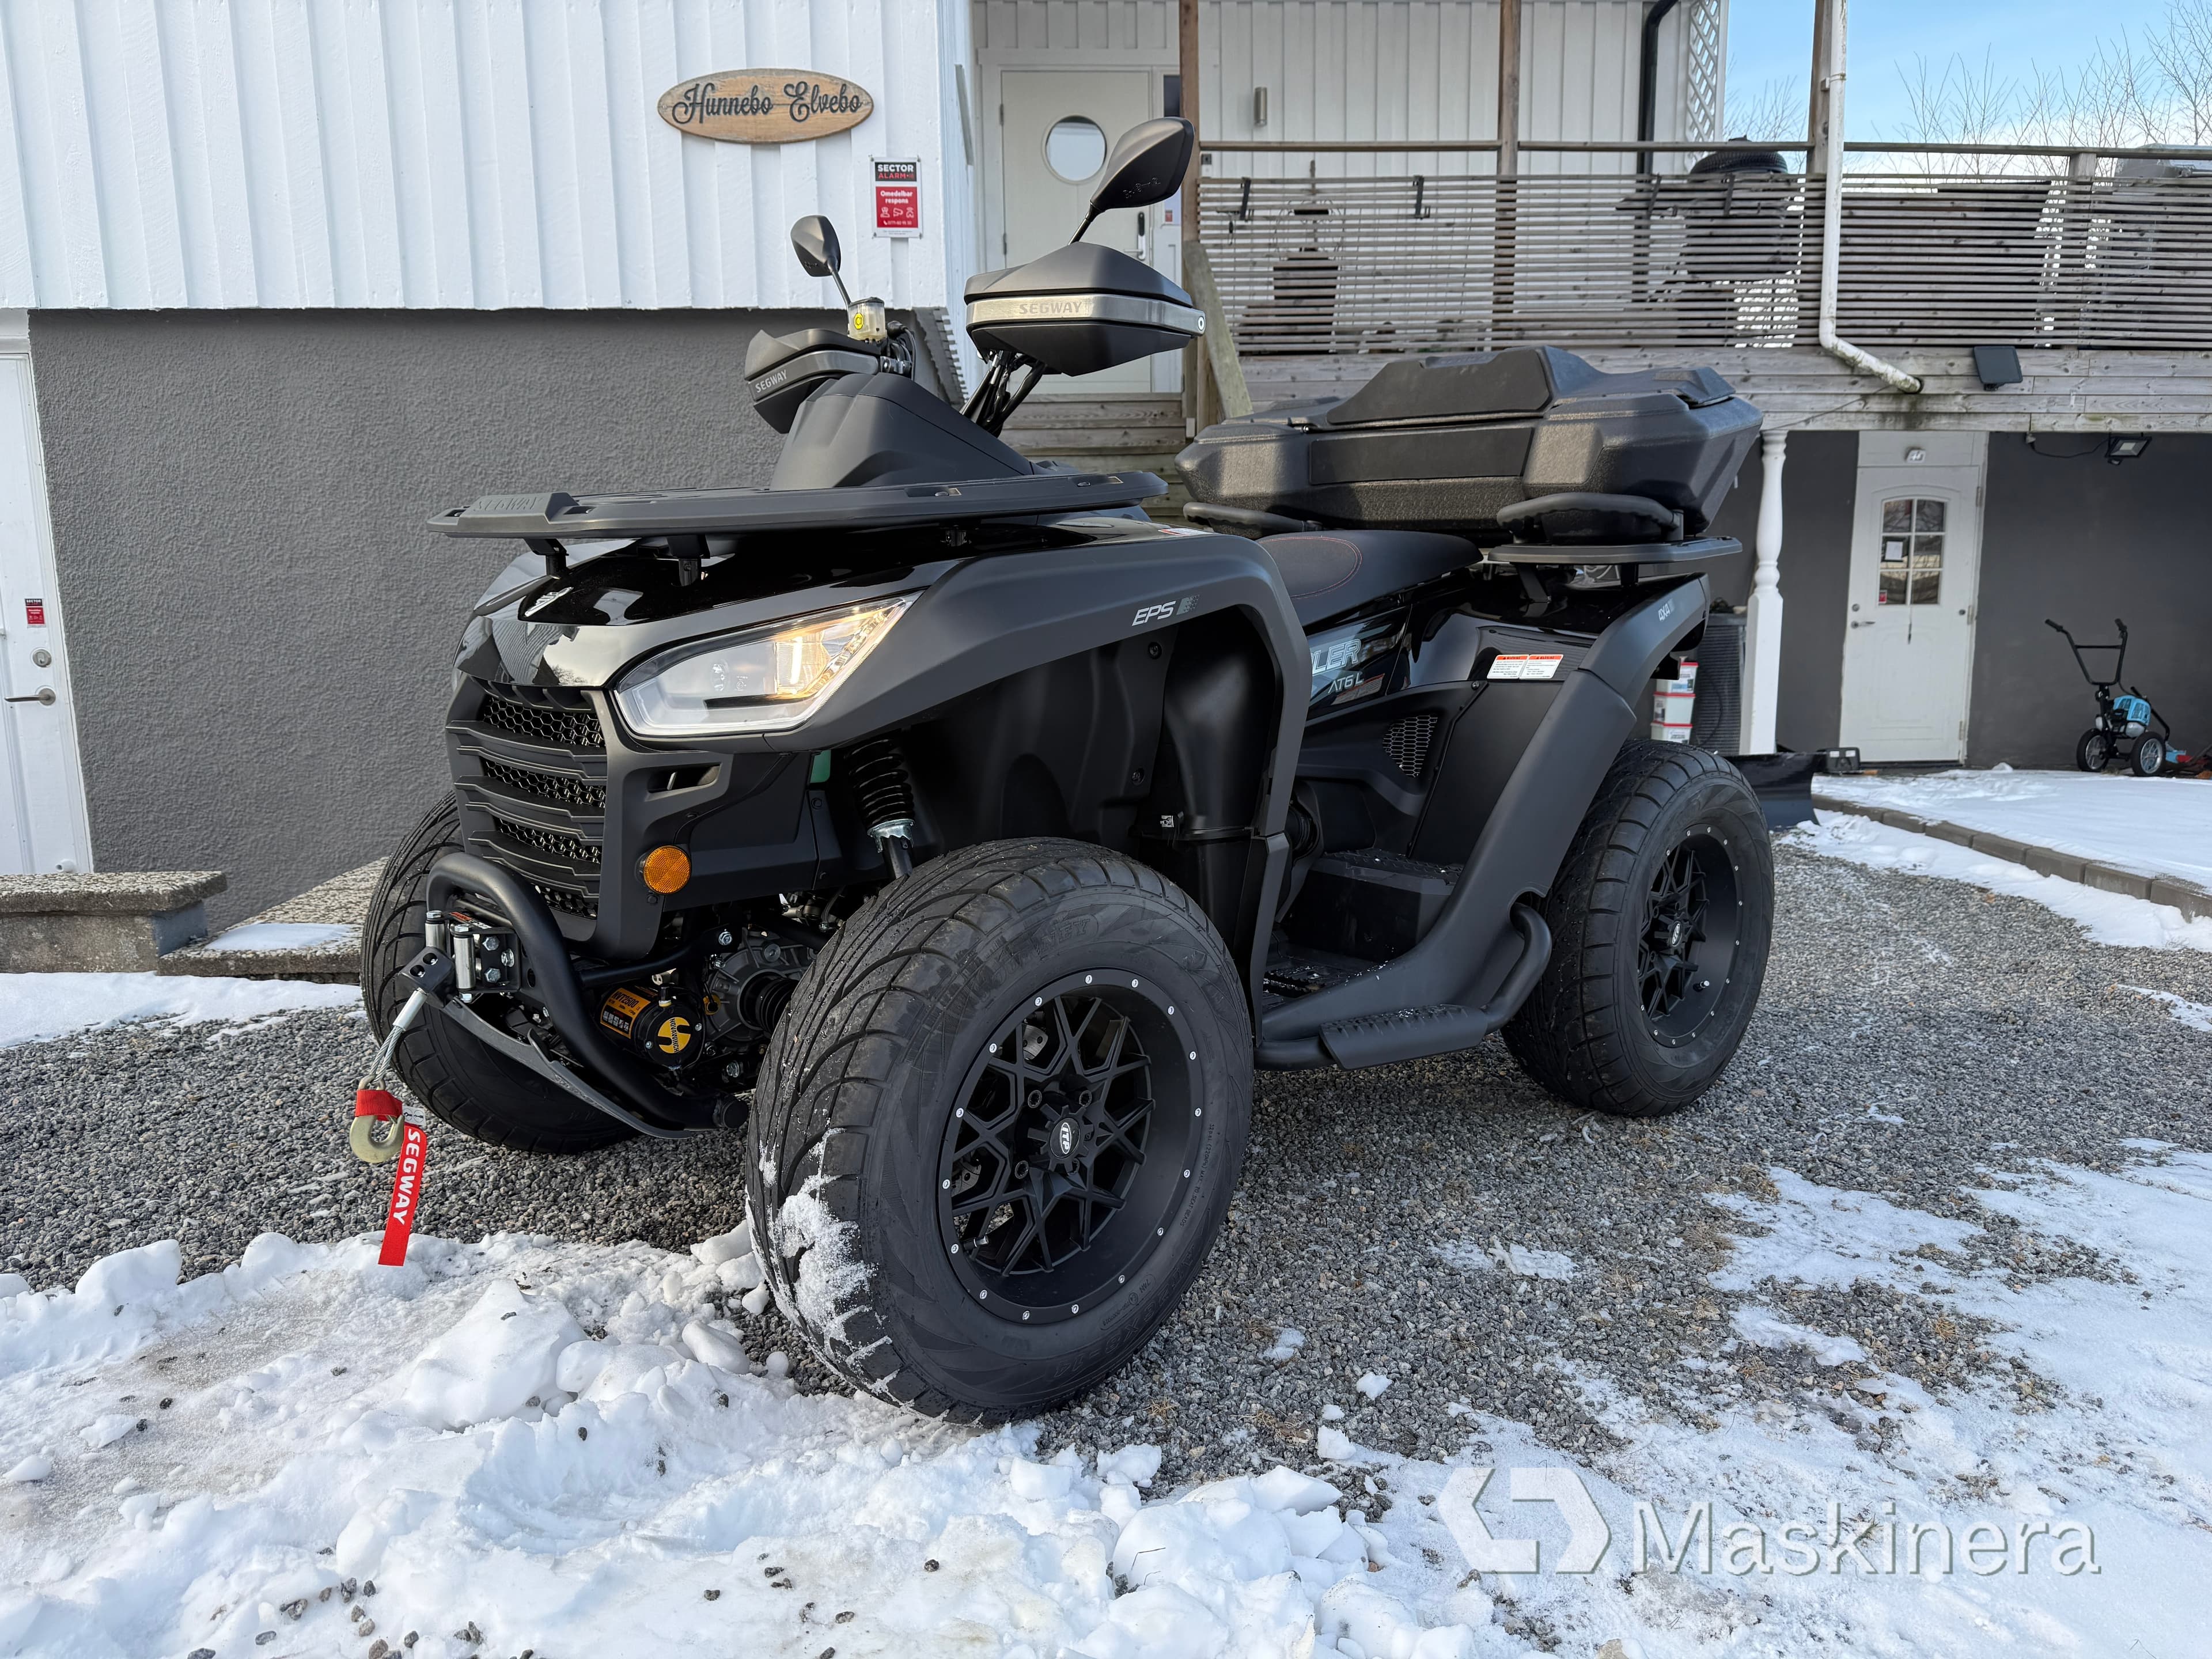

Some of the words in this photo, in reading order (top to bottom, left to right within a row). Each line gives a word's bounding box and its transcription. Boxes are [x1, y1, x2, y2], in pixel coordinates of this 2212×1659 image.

[672, 82, 773, 124] Hunnebo
[783, 81, 863, 122] Elvebo
[877, 164, 914, 172] SECTOR
[1019, 301, 1082, 315] SEGWAY
[755, 369, 787, 393] SEGWAY
[1131, 600, 1176, 626] EPS
[1311, 639, 1361, 677] LER
[669, 1018, 679, 1052] NOVAWINCH
[1061, 1125, 1070, 1152] ITP
[393, 1128, 421, 1225] SEGWAY
